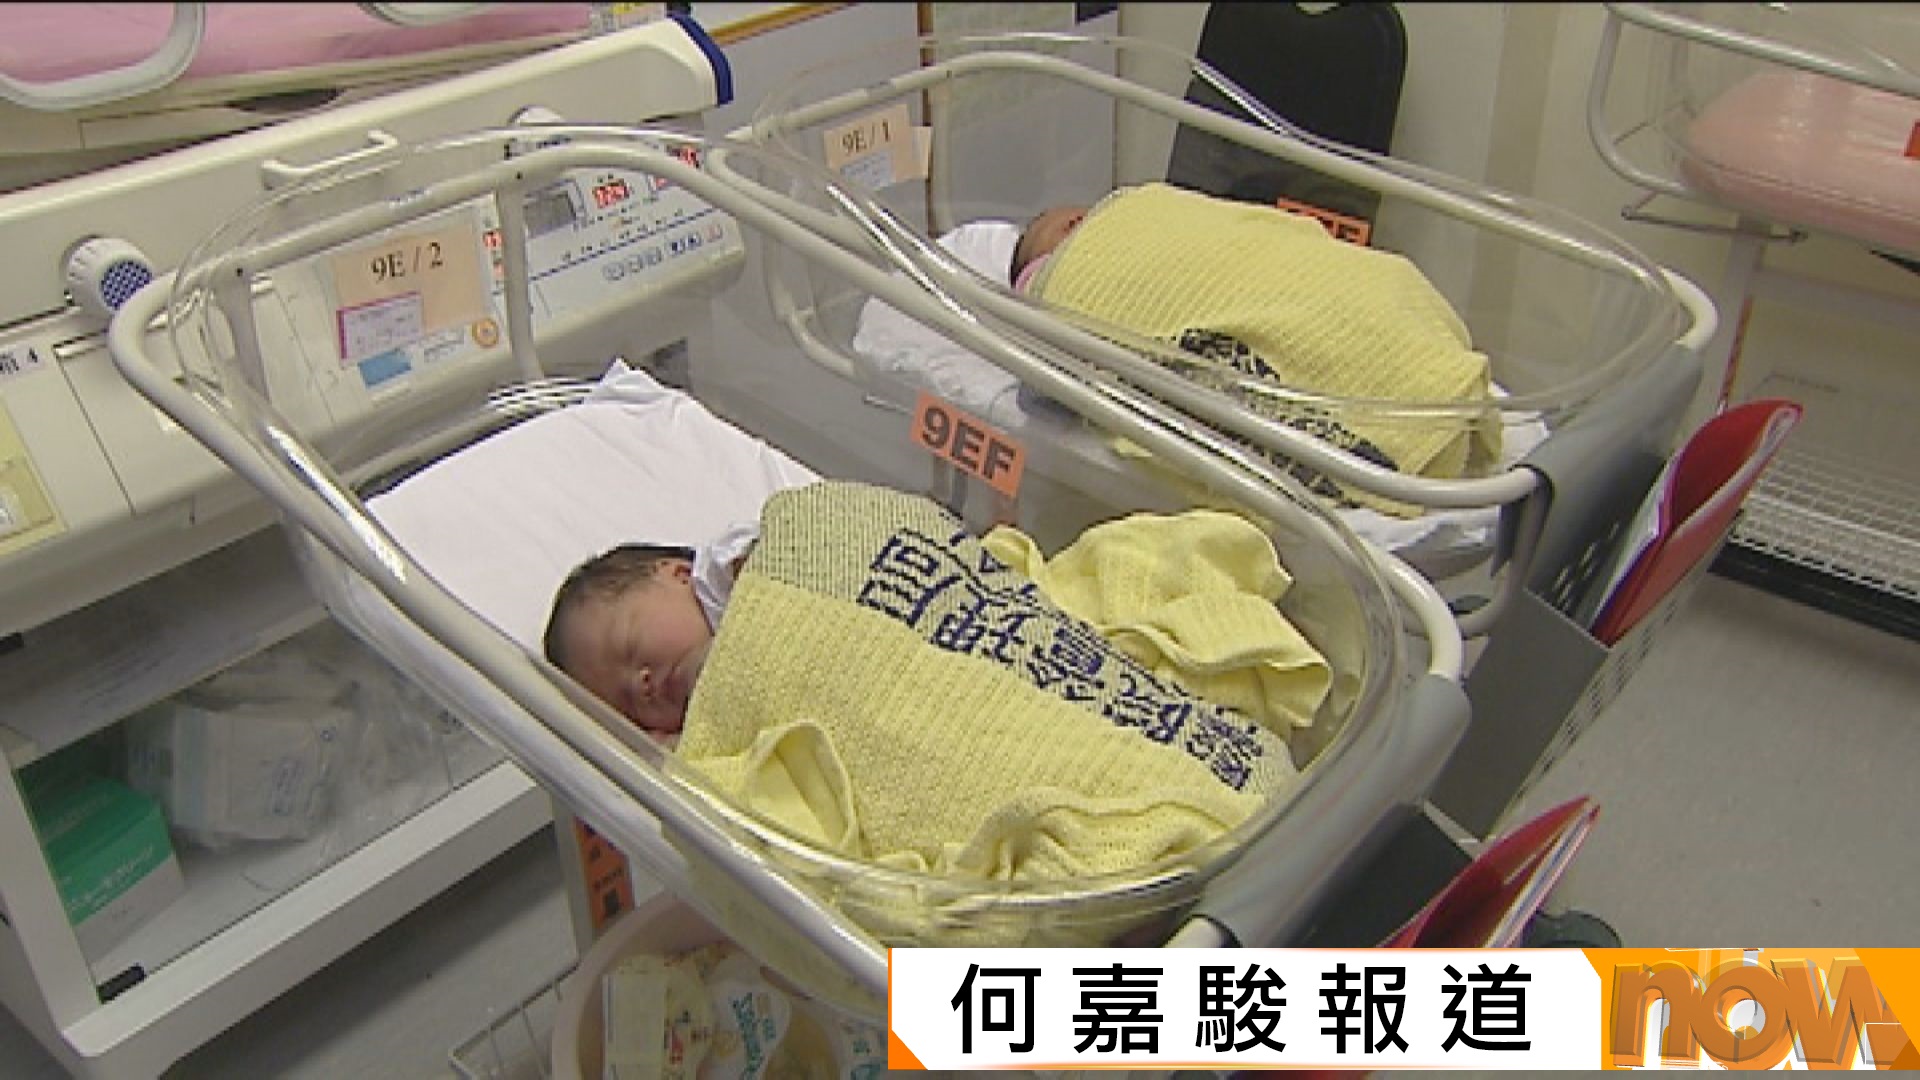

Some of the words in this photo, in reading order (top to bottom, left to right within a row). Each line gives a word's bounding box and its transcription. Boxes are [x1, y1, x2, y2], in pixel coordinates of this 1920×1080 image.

[842, 127, 867, 155] 9E
[371, 251, 406, 283] 9E
[427, 242, 443, 269] 2
[922, 406, 1017, 480] 9EF
